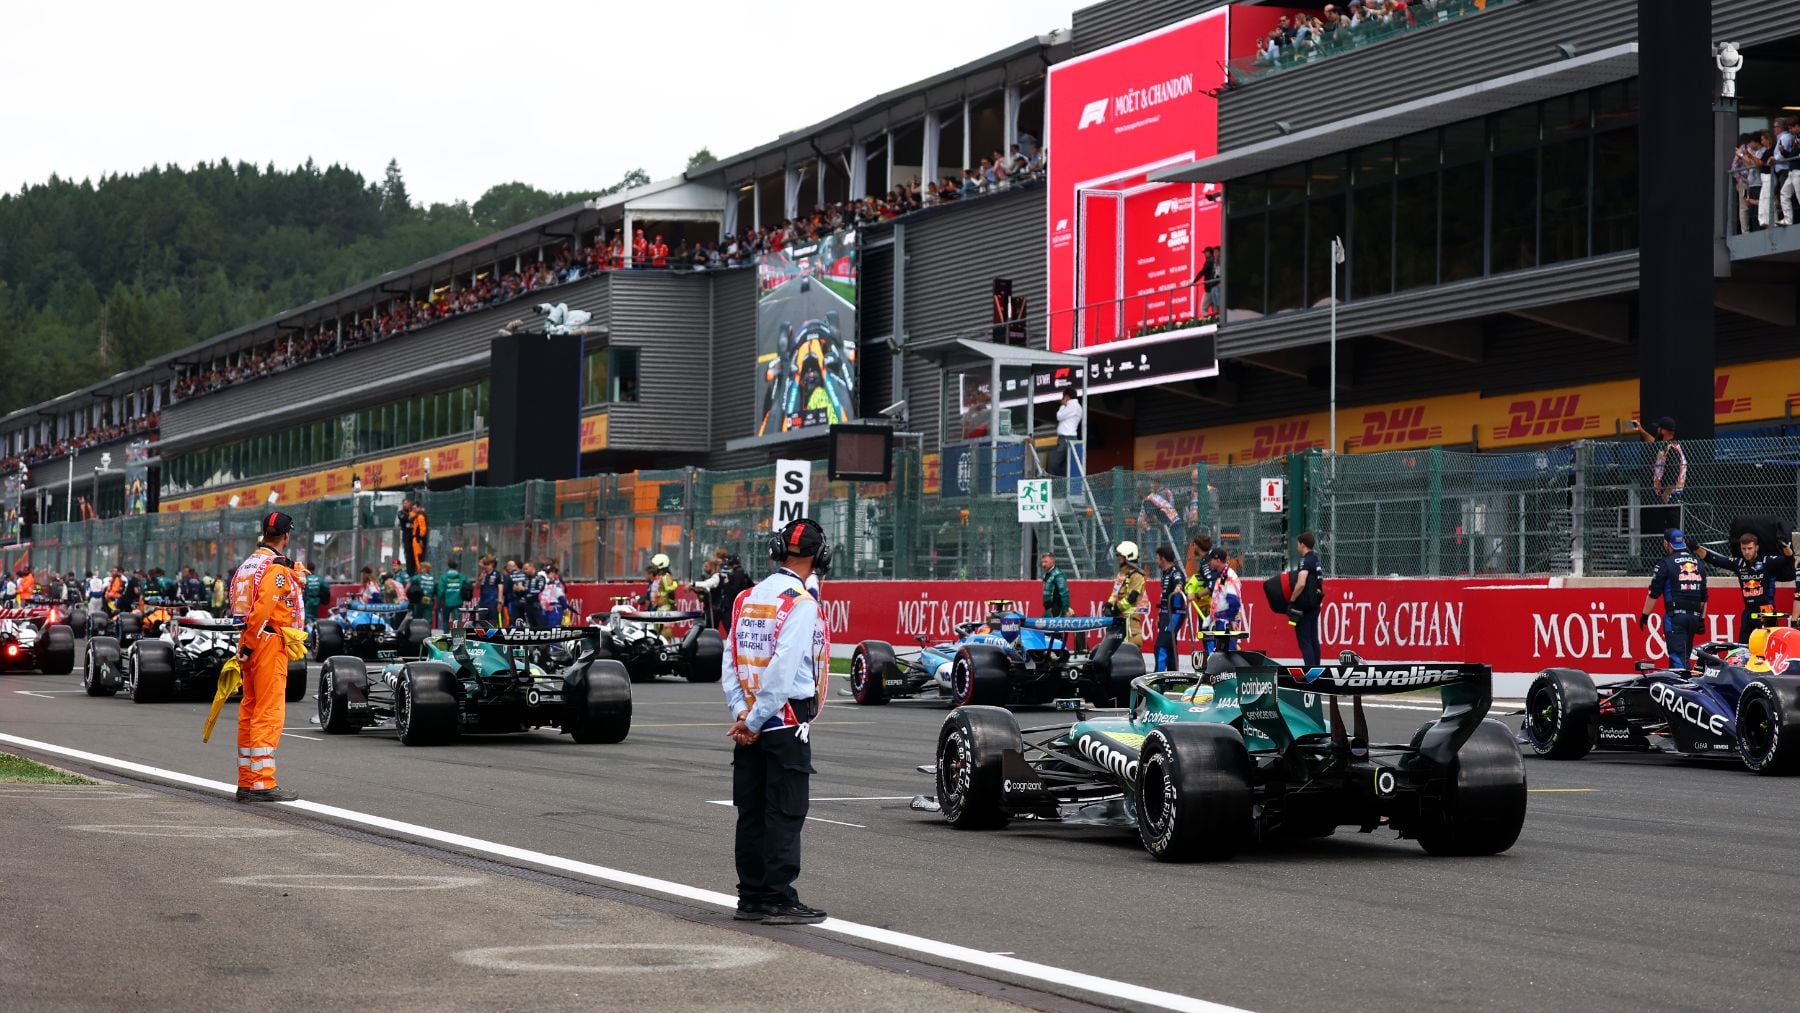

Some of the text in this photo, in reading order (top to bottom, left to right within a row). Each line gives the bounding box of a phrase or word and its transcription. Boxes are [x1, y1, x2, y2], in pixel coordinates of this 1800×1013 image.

[1115, 73, 1193, 116] MOËT & CHANDON
[1362, 406, 1430, 446] DHL
[1508, 394, 1585, 438] DHL
[1155, 435, 1207, 470] DHL
[1253, 420, 1312, 458] DHL
[783, 470, 803, 494] S
[779, 501, 803, 521] M
[896, 592, 940, 635] MOËT
[940, 600, 949, 635] &
[1048, 618, 1103, 629] BARCLAYS
[1318, 592, 1371, 645] OËT
[1374, 601, 1390, 646] &
[1532, 602, 1636, 658] MOËT
[1645, 612, 1669, 660] &
[501, 628, 583, 641] Valvoline
[1241, 677, 1273, 695] coinbase
[1329, 666, 1459, 687] Valvoline
[1147, 710, 1179, 723] cohere
[1247, 708, 1279, 721] servicenow
[1649, 682, 1728, 736] ORACLE
[1078, 734, 1140, 783] aramc
[1013, 781, 1042, 792] cognizant
